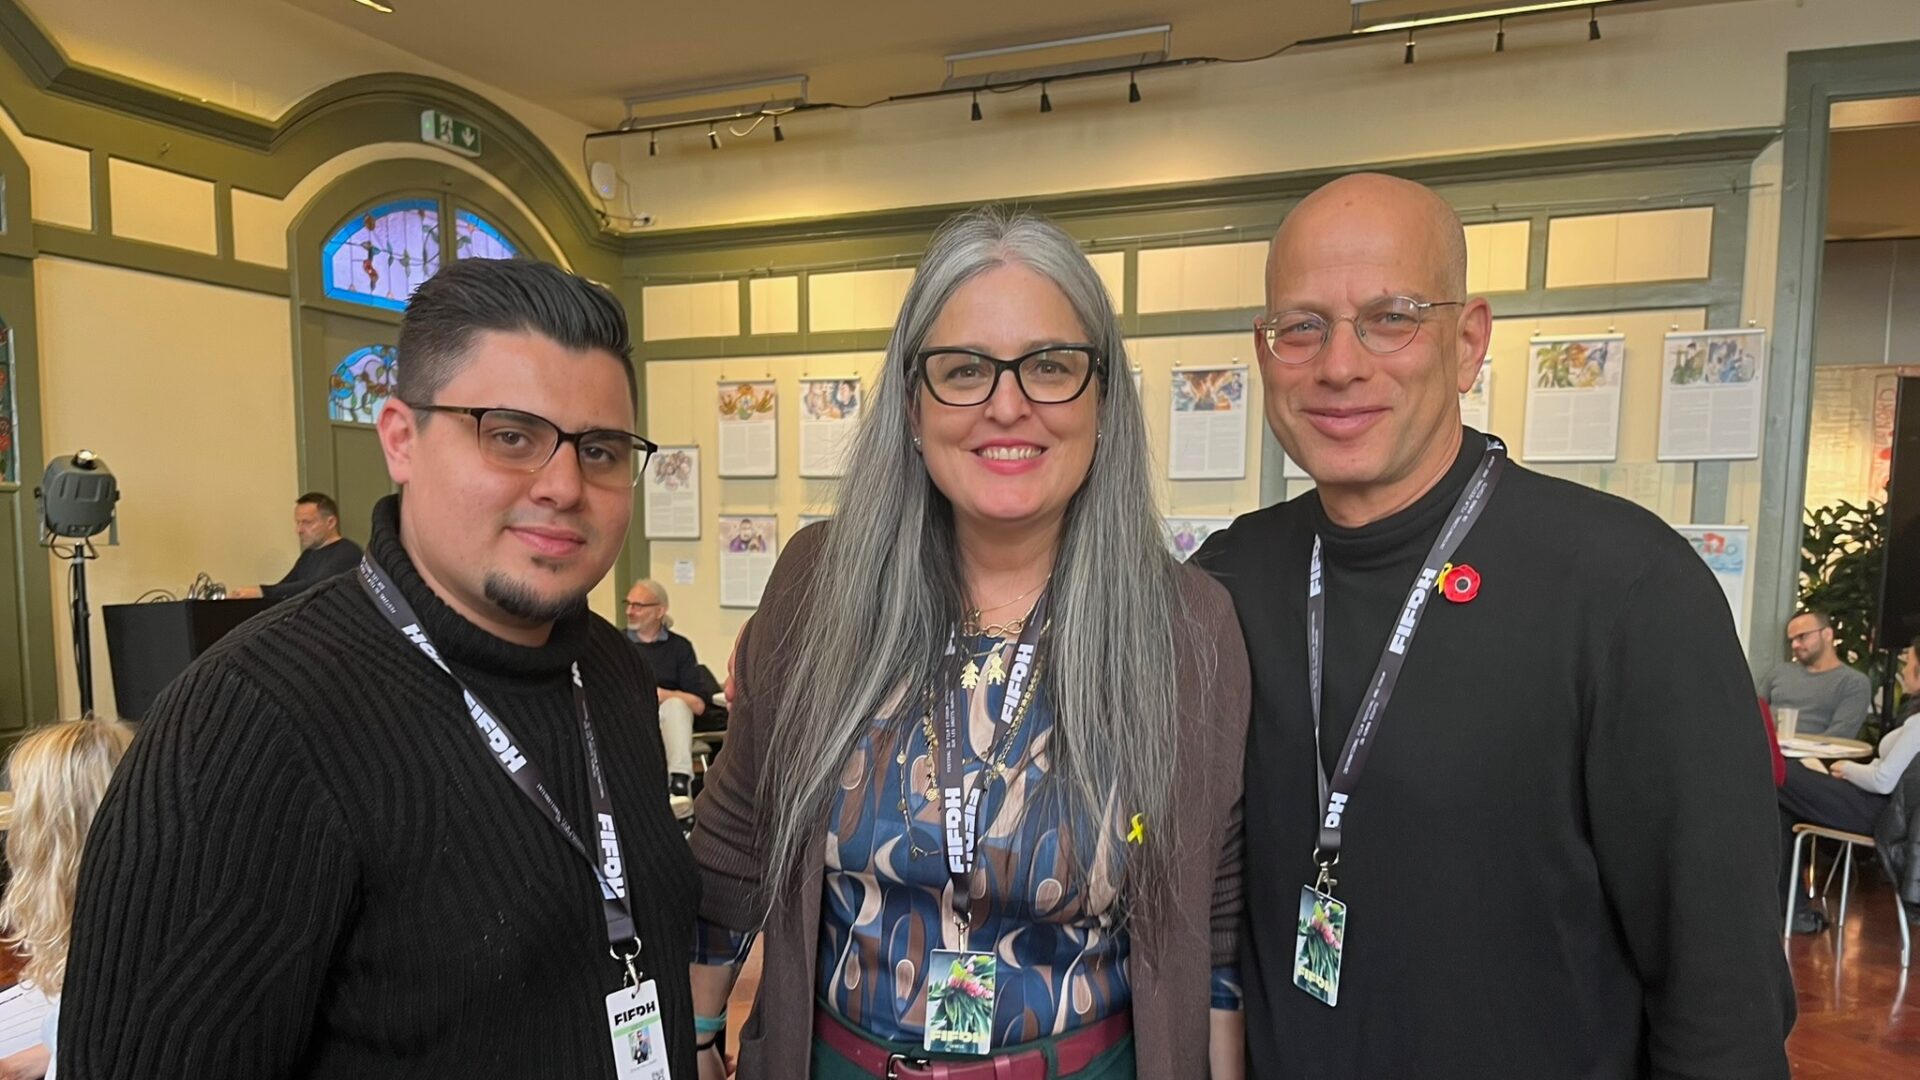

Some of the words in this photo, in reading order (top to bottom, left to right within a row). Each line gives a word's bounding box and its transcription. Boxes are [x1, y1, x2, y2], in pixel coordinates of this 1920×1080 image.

[1389, 567, 1438, 656] FIFDH
[1000, 643, 1035, 725] FIFDH
[945, 787, 966, 874] FIFDH
[614, 1000, 656, 1026] FIFDH
